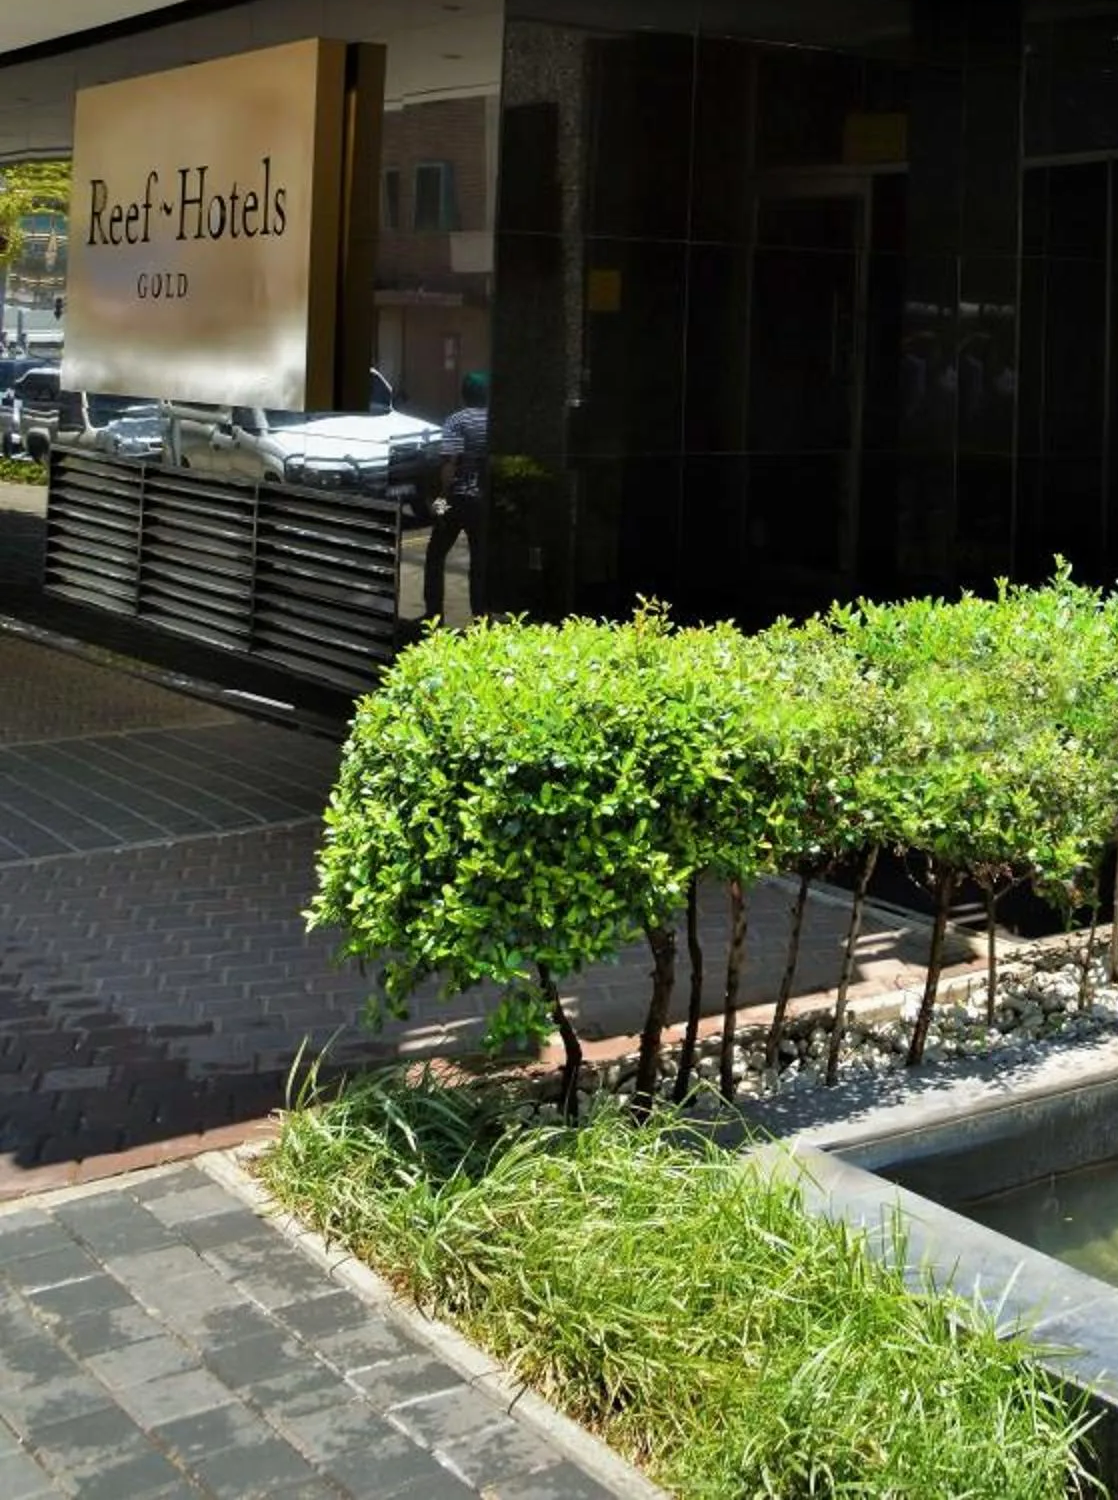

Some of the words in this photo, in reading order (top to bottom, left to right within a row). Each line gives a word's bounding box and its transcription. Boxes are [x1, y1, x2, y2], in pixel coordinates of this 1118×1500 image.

[87, 170, 159, 247] Reef
[176, 156, 287, 241] Hotels
[137, 272, 189, 299] GOLD
